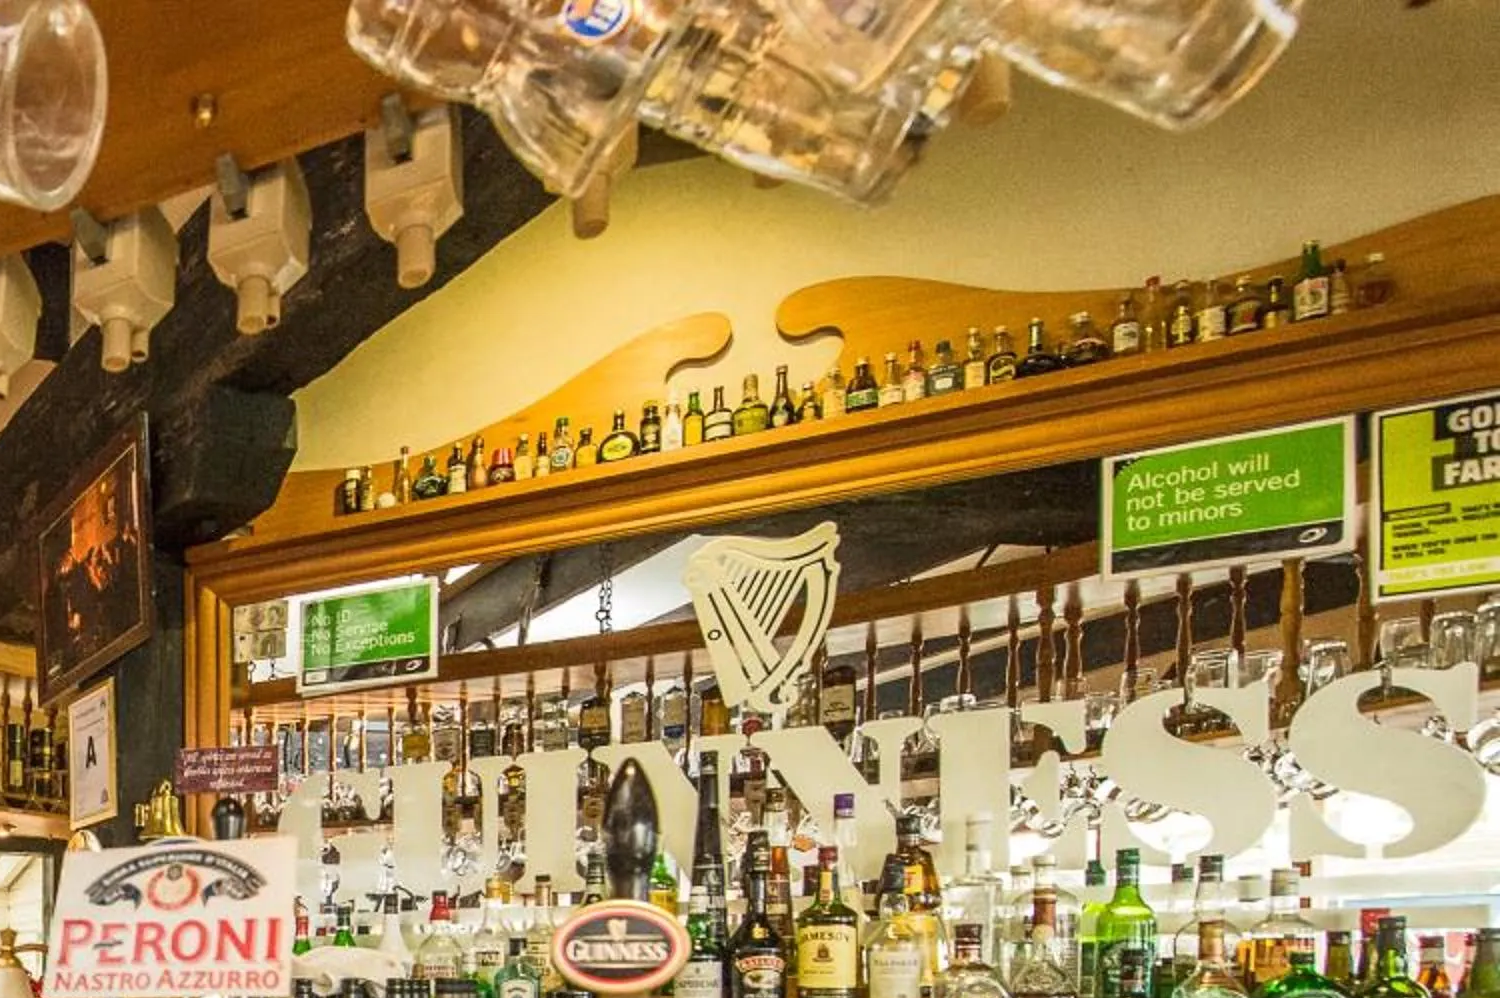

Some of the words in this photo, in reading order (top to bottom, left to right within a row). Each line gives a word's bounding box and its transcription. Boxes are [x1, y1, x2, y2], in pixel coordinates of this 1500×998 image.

[1447, 404, 1500, 432] GO
[1127, 461, 1219, 493] Alcohol
[1227, 452, 1270, 477] will
[1443, 455, 1500, 486] FAR
[1126, 490, 1163, 512] not
[1175, 483, 1205, 504] be
[1214, 469, 1301, 498] served
[1126, 513, 1151, 532] to
[1158, 500, 1244, 528] minors
[311, 614, 330, 628] No
[336, 608, 350, 623] ID
[311, 629, 330, 643] No
[335, 620, 389, 639] Service
[336, 630, 416, 653] Exceptions
[85, 735, 97, 769] A
[57, 916, 283, 967] PERONI
[566, 939, 668, 962] GUINNESS
[53, 970, 151, 992] NASTRO
[156, 968, 280, 991] AZZURRO
